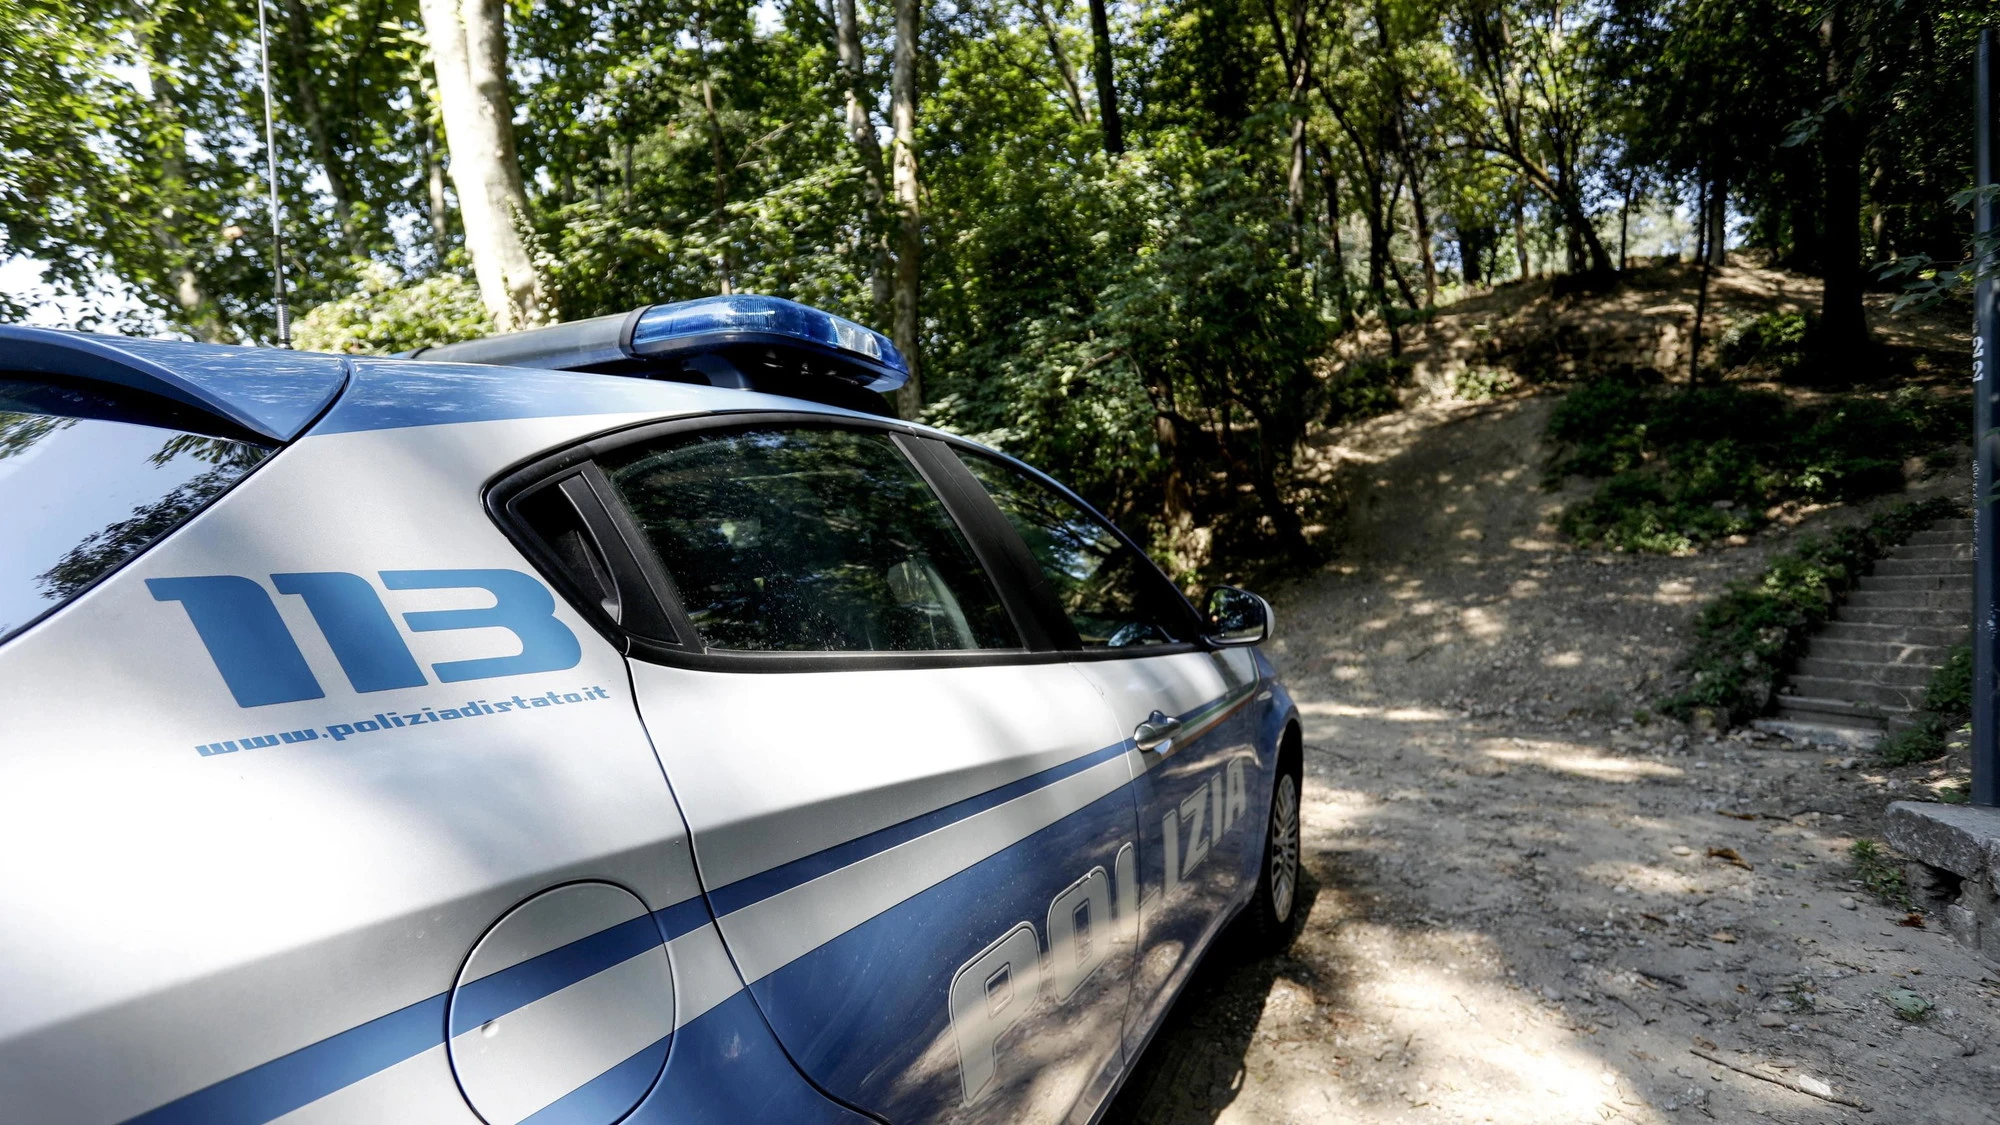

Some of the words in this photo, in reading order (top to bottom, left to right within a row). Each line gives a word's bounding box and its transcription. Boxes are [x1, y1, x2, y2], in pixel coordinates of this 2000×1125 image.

[144, 569, 582, 708] 113
[195, 685, 611, 757] www.poliziadistato.it
[949, 757, 1247, 1107] POLIZIA
